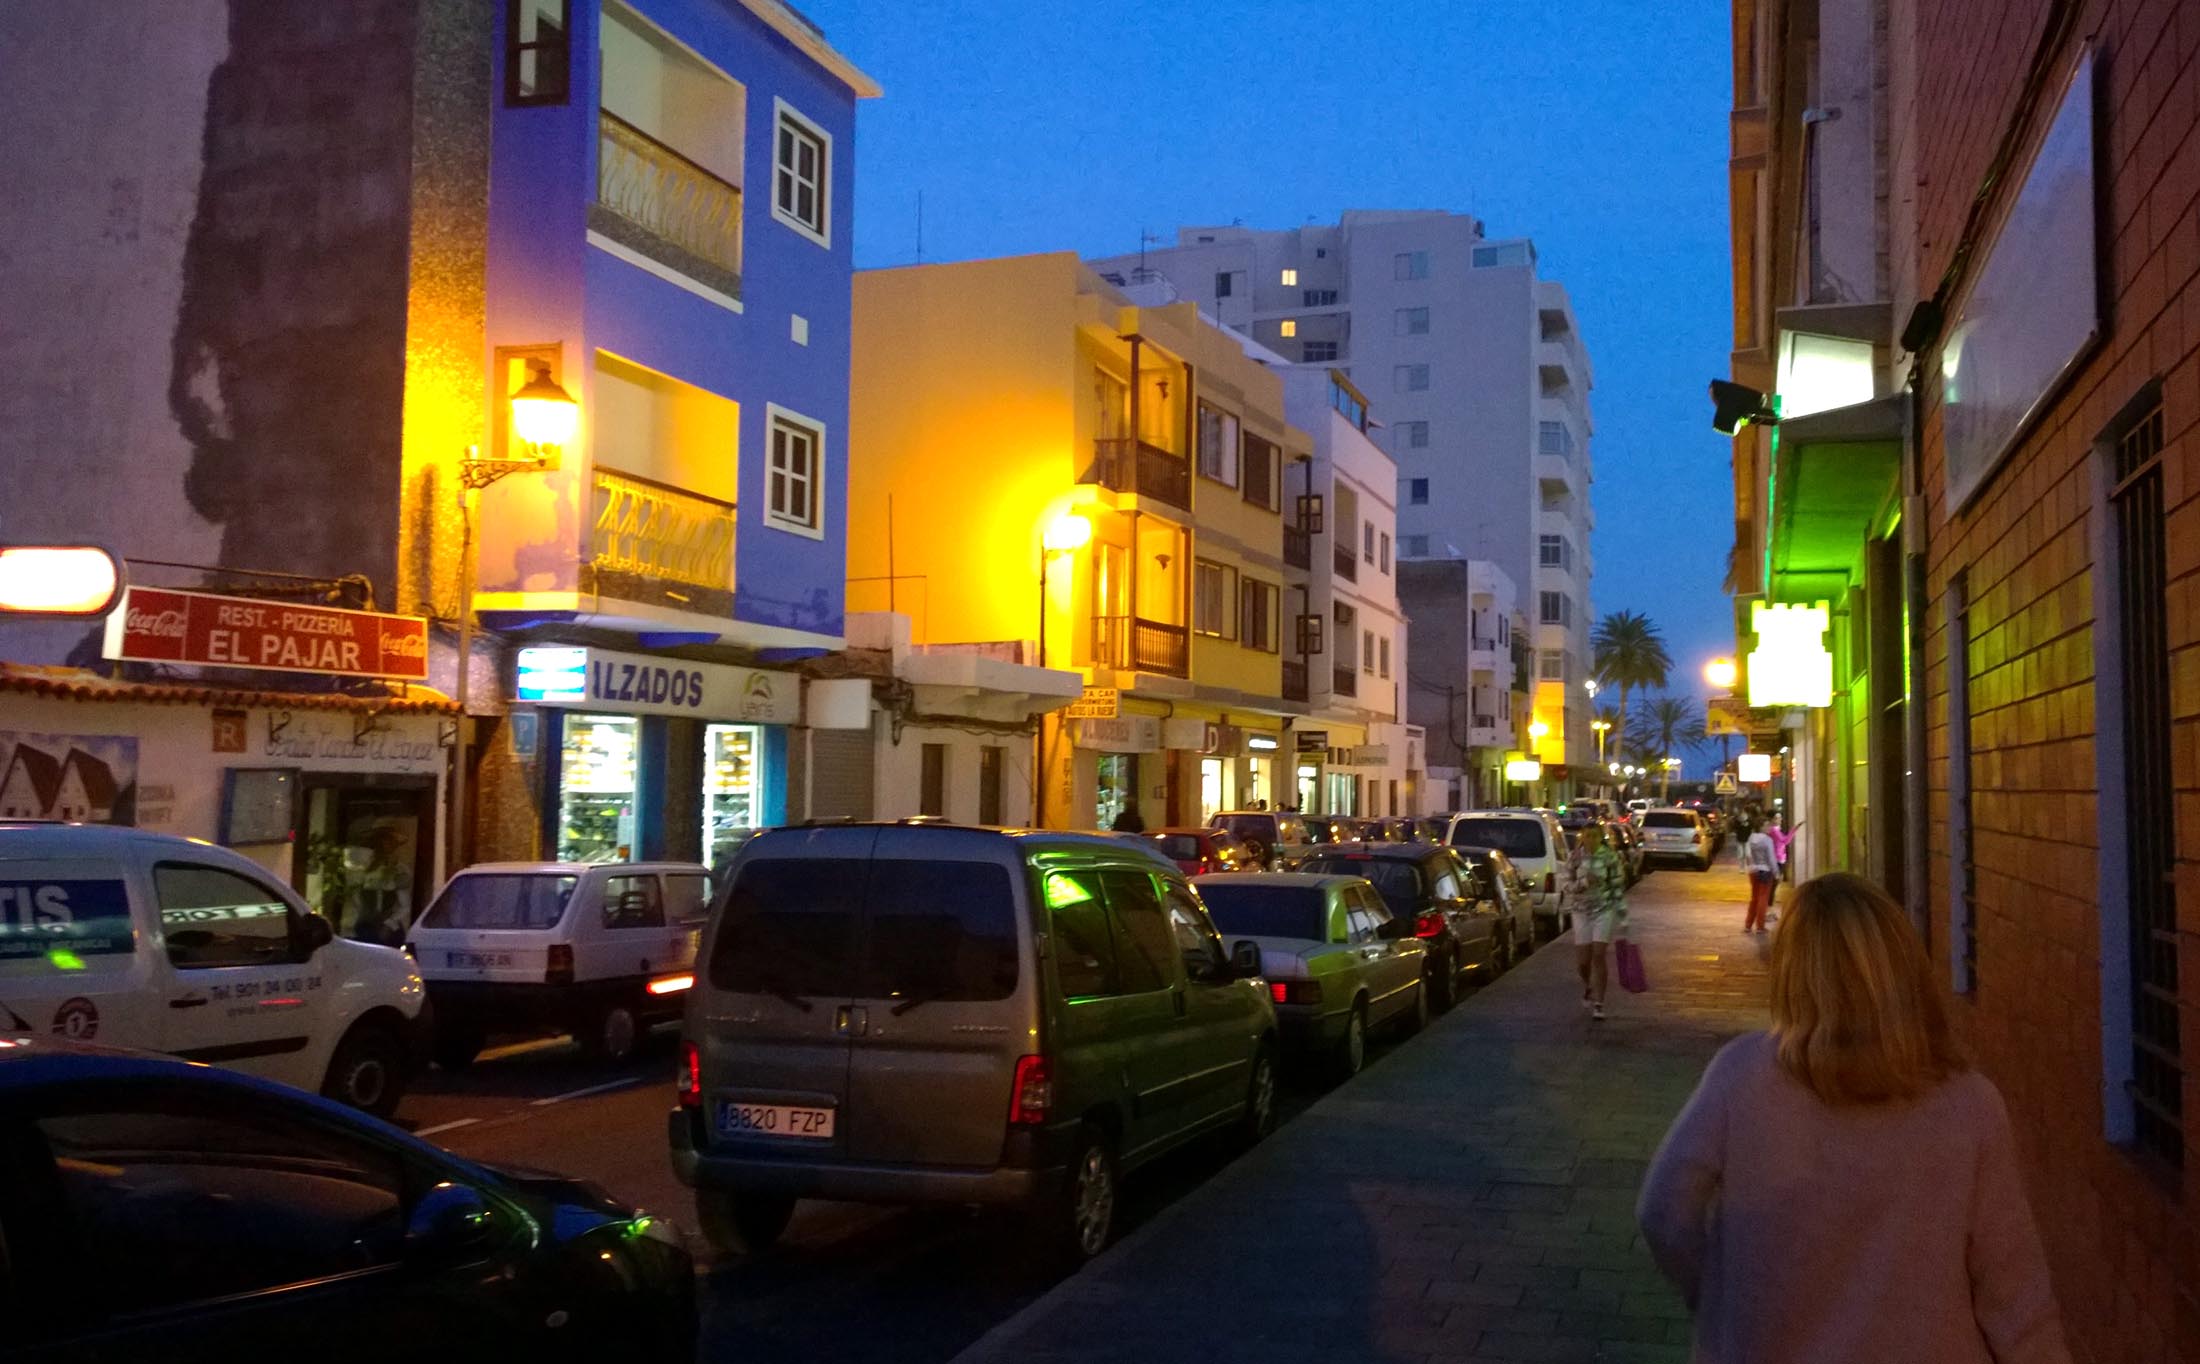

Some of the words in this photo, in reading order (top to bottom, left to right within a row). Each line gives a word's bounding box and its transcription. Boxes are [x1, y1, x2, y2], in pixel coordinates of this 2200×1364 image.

[218, 605, 267, 629] REST.
[207, 629, 250, 663] EL
[259, 634, 361, 671] PAJAR
[789, 1110, 827, 1133] FZP
